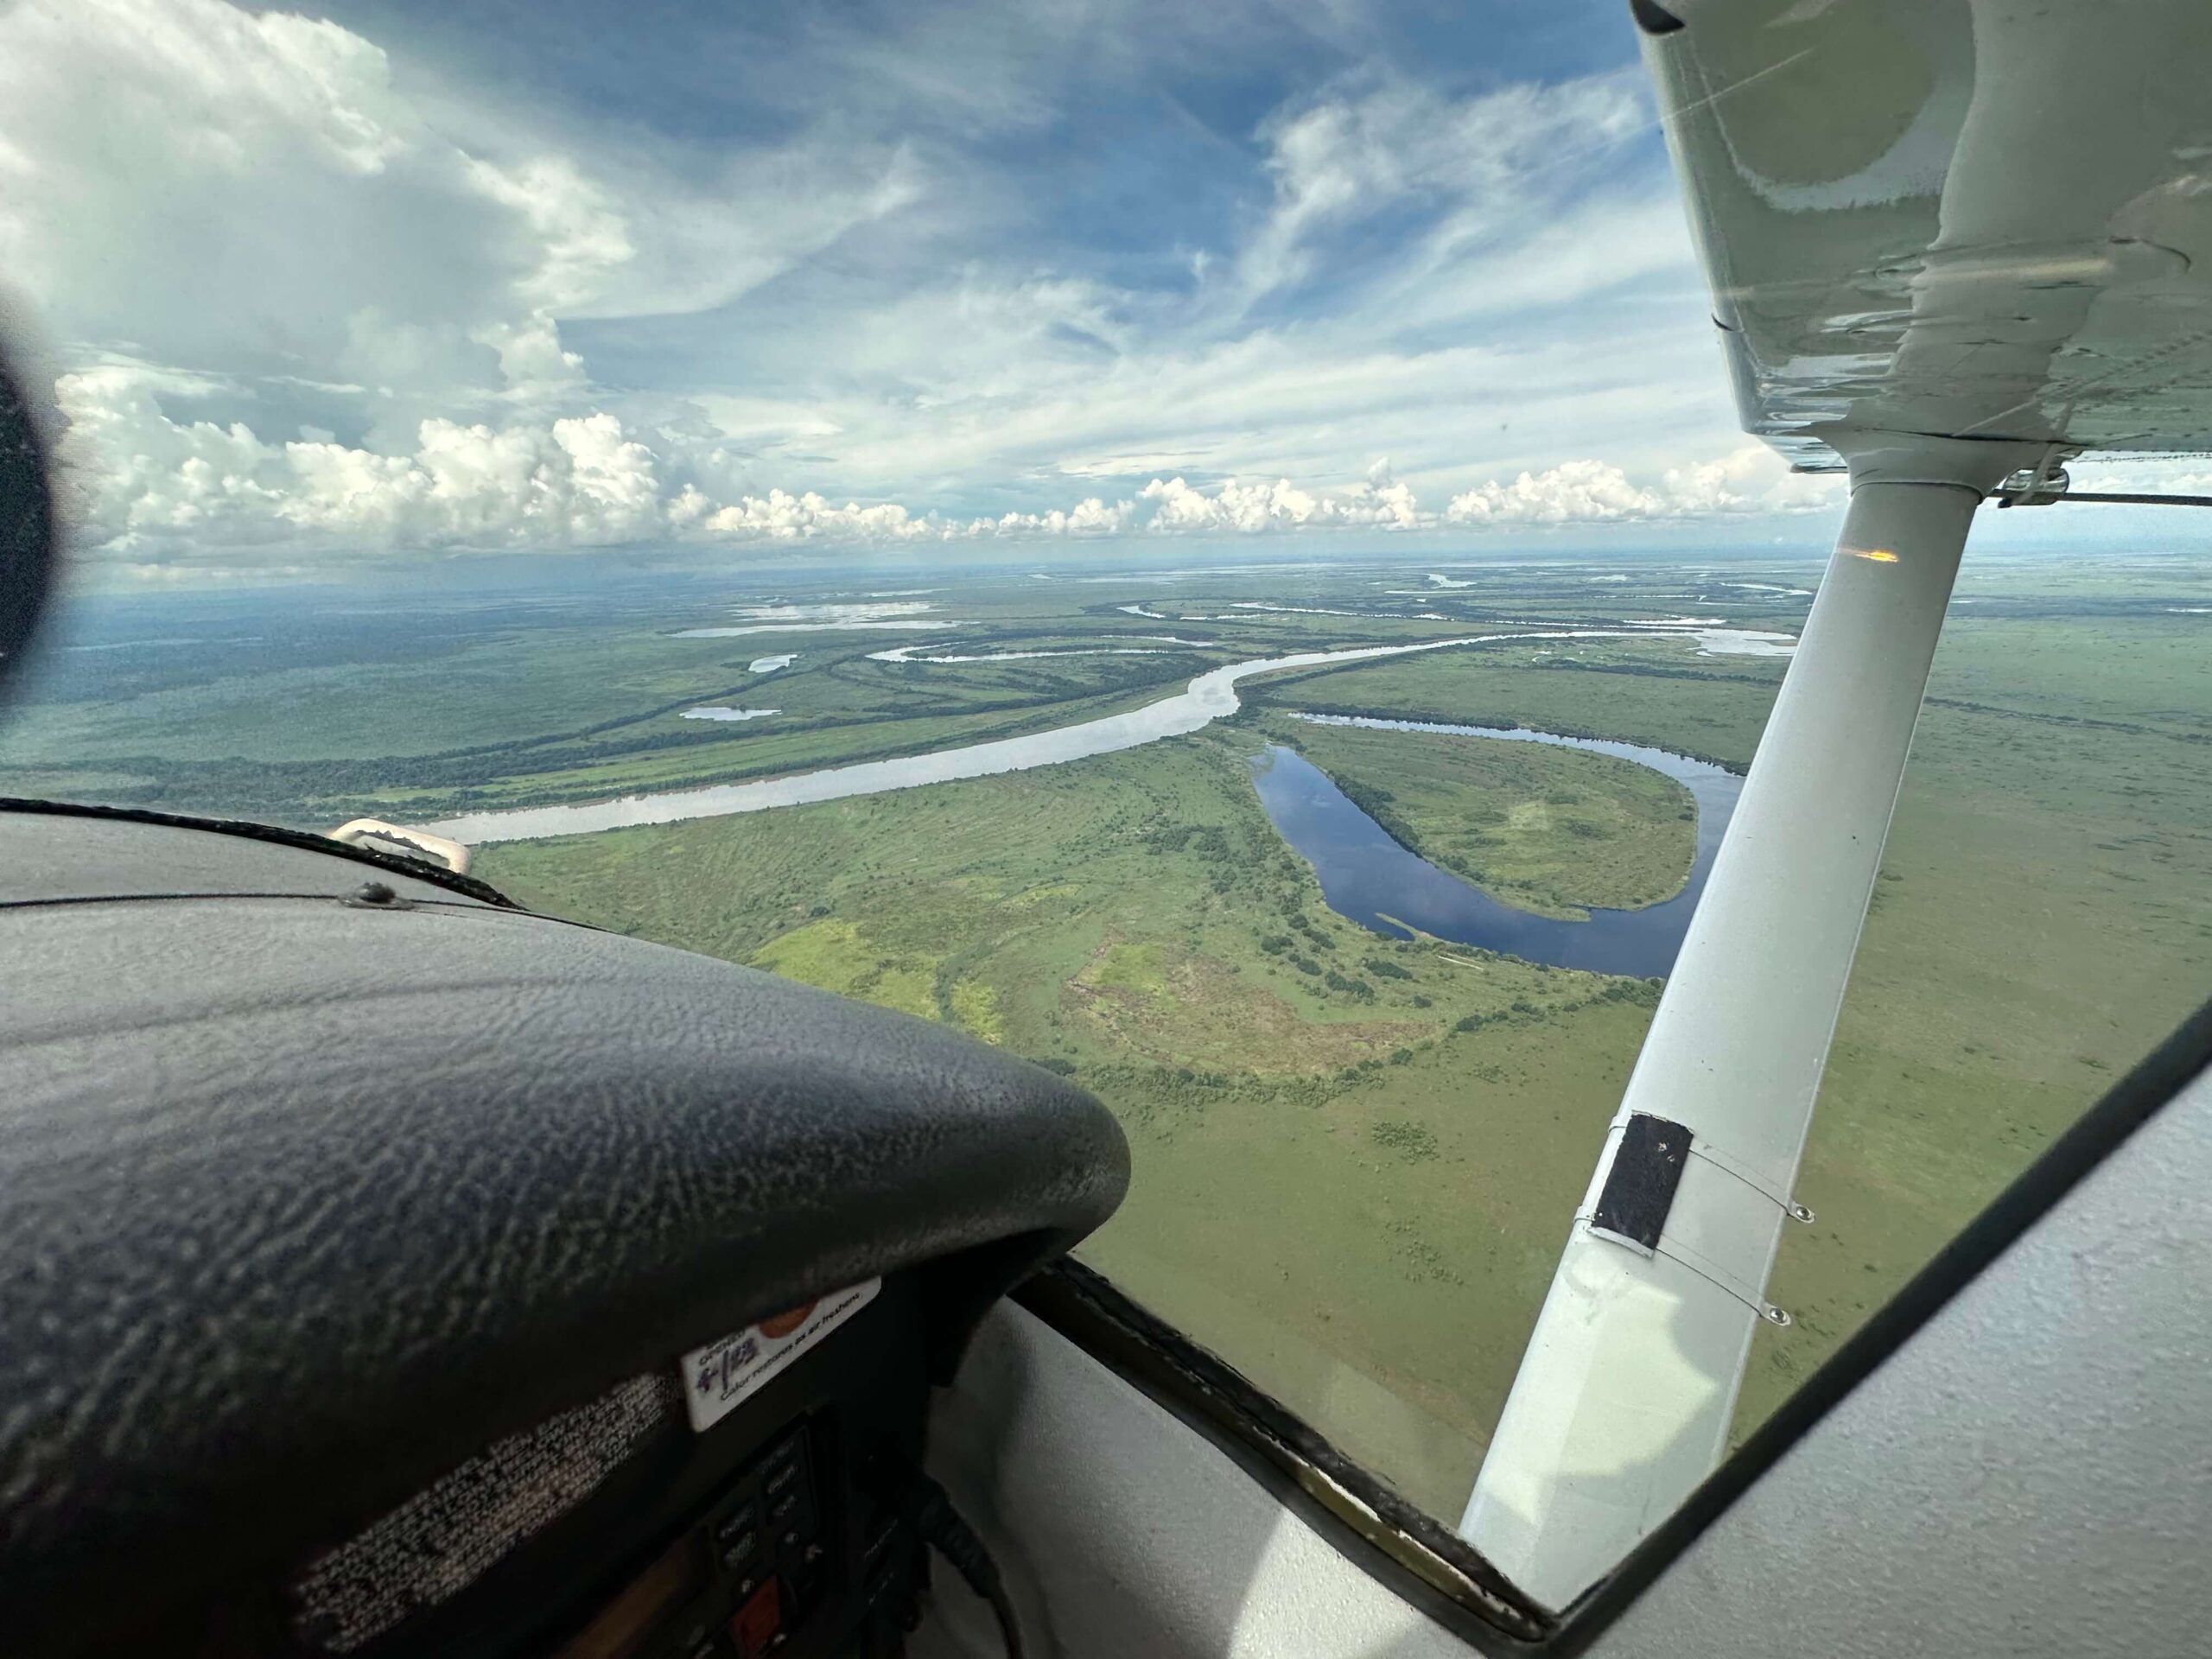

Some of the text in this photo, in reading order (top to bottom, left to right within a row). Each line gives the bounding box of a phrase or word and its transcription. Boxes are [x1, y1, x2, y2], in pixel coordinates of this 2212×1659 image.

[721, 1292, 860, 1401] Color restores as air freshens
